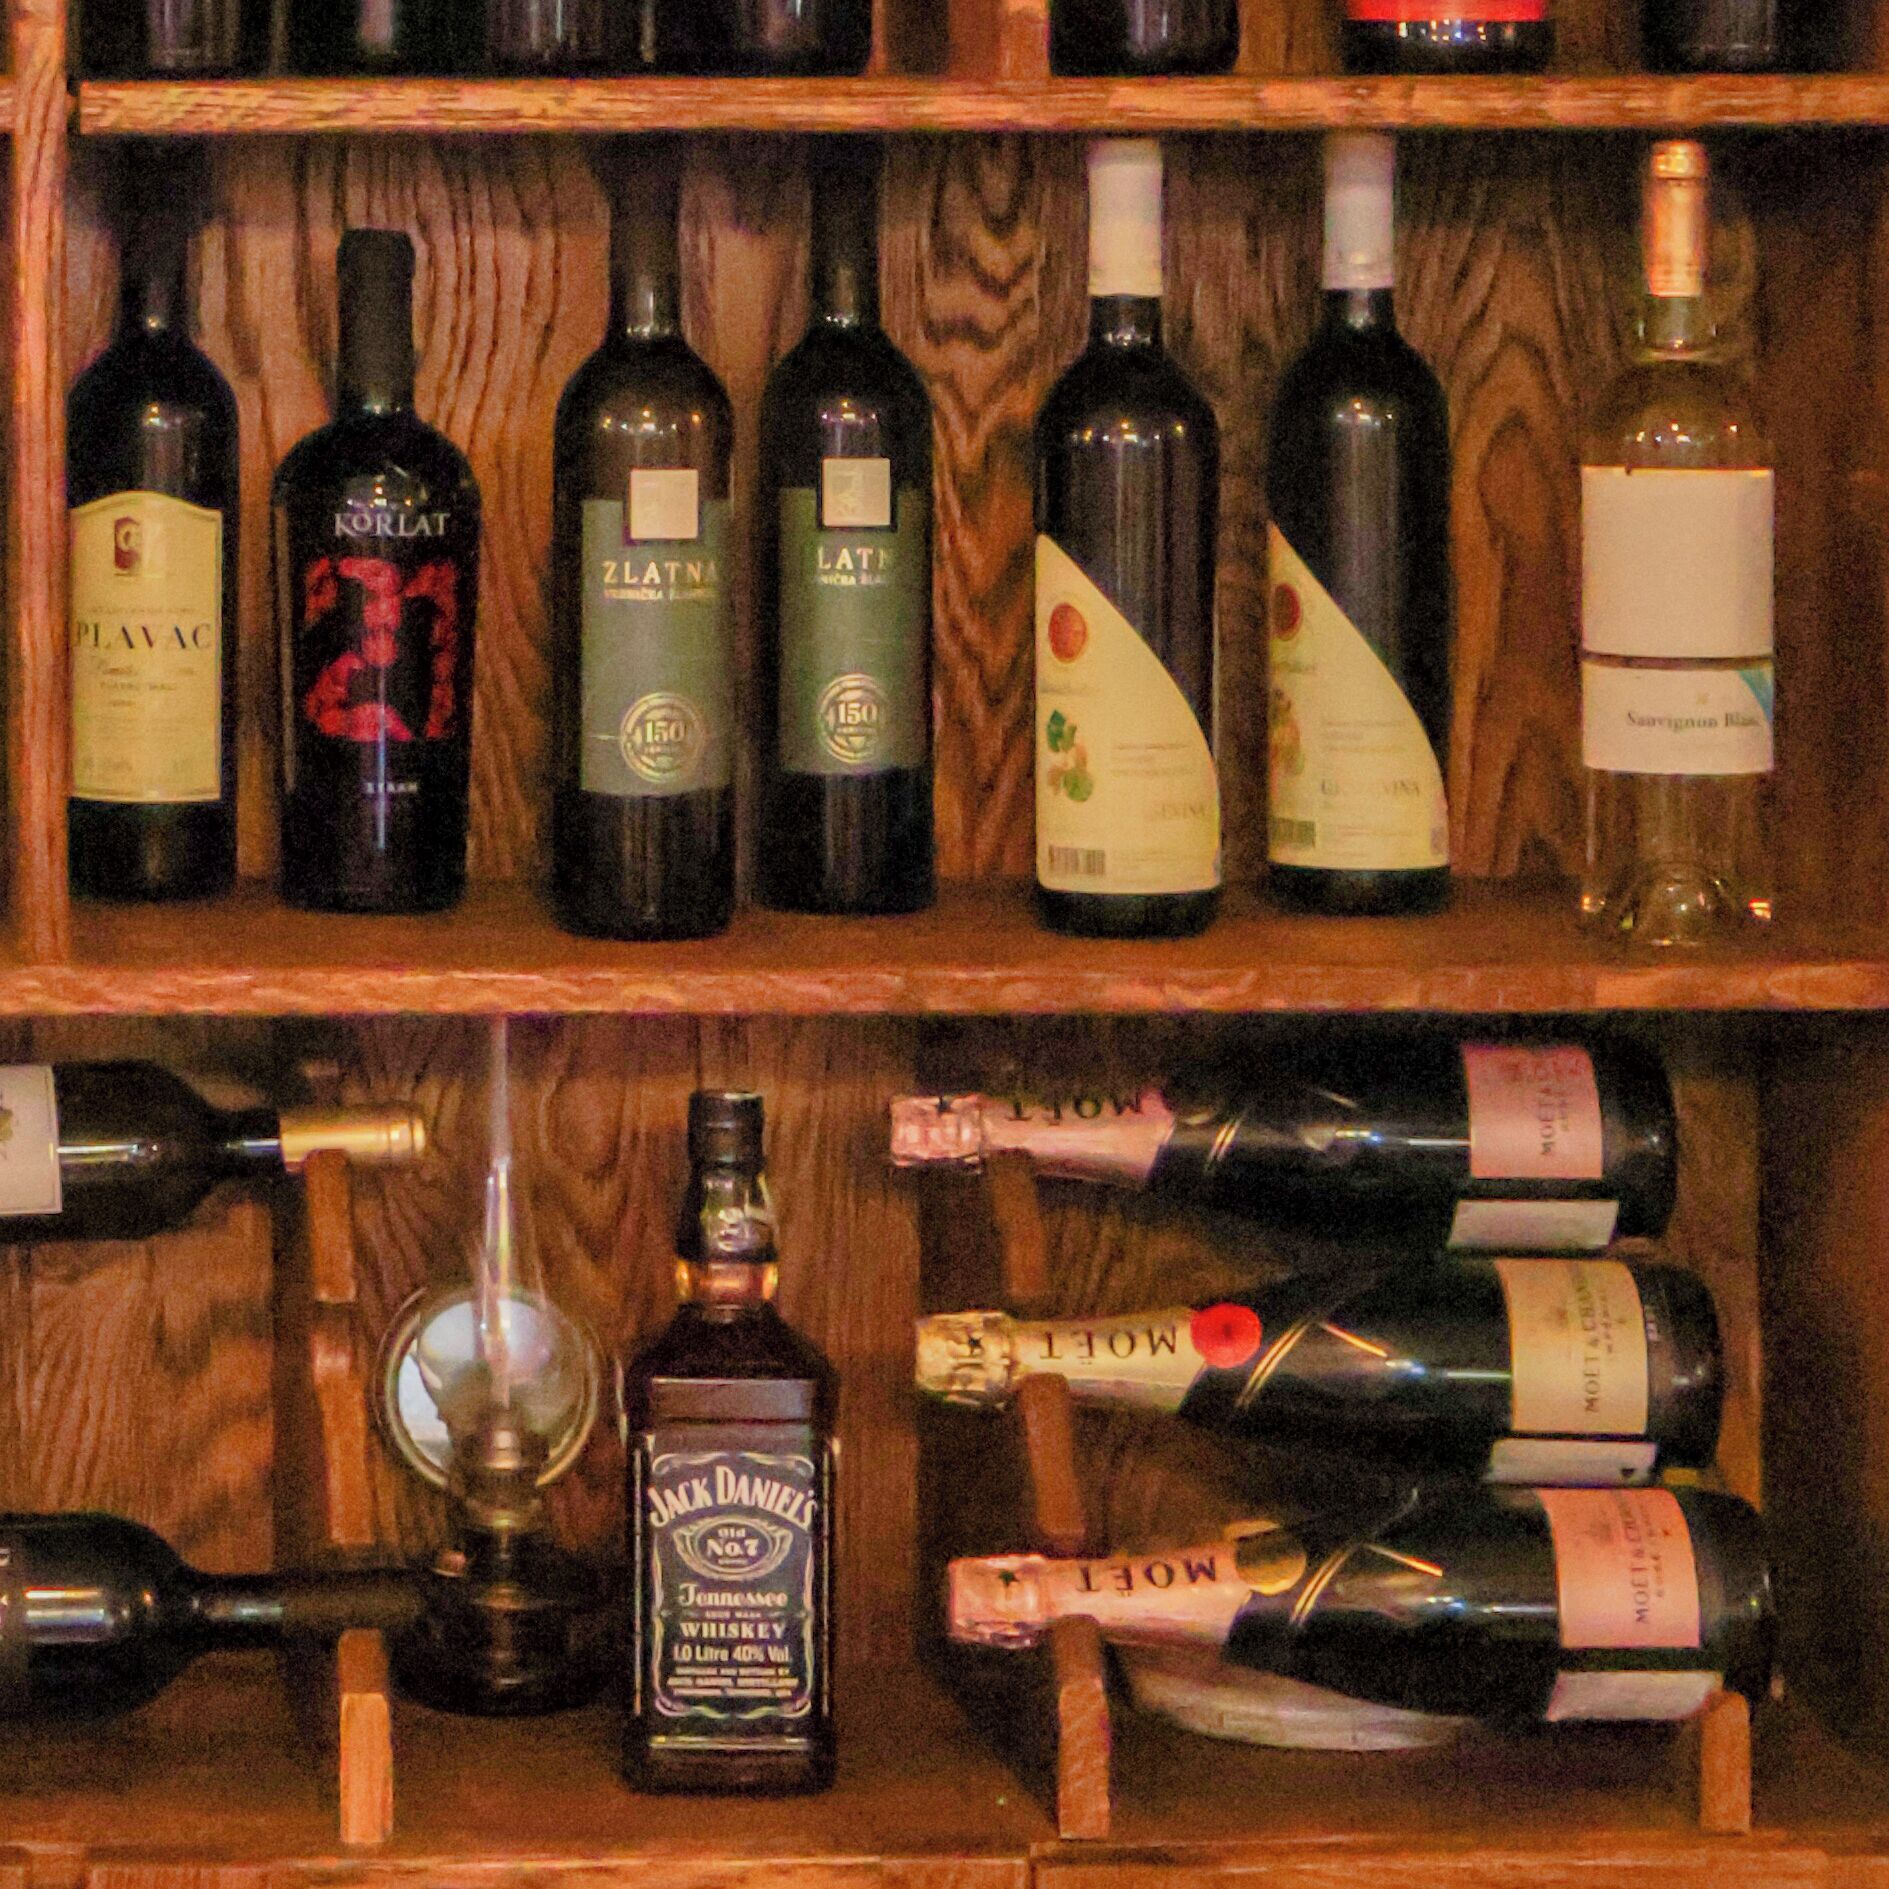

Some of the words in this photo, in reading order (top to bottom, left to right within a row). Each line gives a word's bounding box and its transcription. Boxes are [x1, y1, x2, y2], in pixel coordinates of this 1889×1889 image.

[335, 513, 451, 538] KORLAT
[602, 559, 719, 585] ZLATNA
[75, 620, 212, 652] PLAVAC
[836, 701, 879, 725] 150
[1626, 712, 1719, 735] Sauvignon
[644, 719, 686, 743] 150
[1041, 1324, 1177, 1366] MOËT
[648, 1476, 713, 1527] JACK
[715, 1465, 818, 1532] DANIEL'S
[1076, 1554, 1218, 1598] MOËT
[678, 1582, 789, 1607] Tennessee
[679, 1621, 787, 1639] WHISKEY
[732, 1645, 765, 1662] 40%
